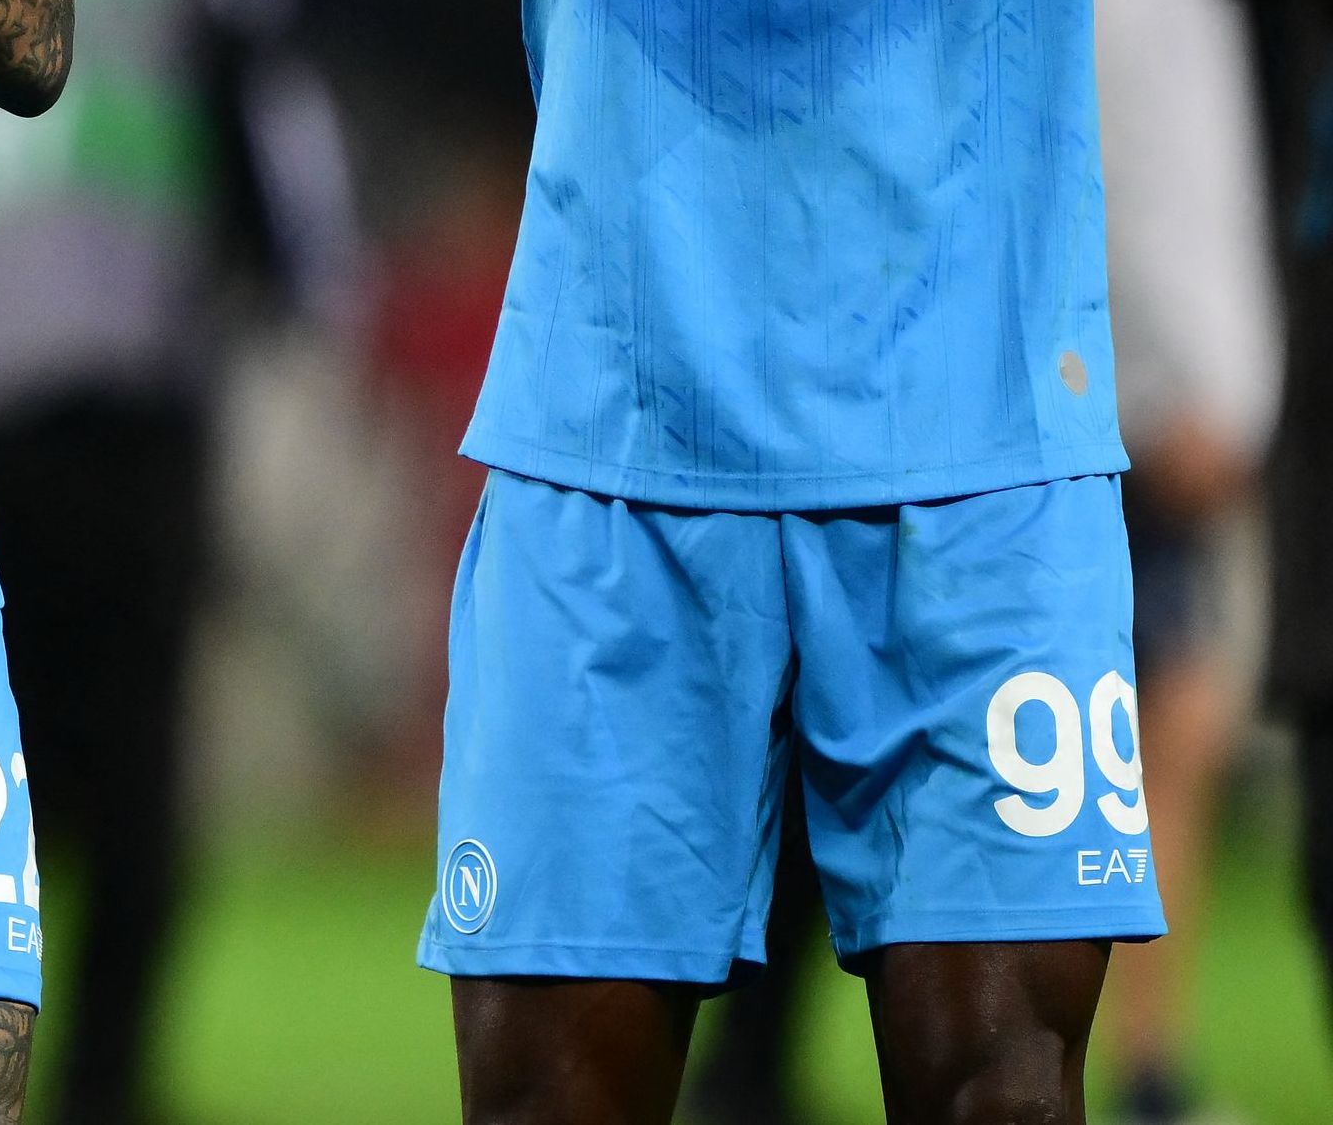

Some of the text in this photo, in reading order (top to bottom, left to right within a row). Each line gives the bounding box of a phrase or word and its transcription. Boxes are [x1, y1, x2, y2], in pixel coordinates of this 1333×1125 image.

[986, 670, 1149, 837] 99
[457, 866, 483, 908] N
[1077, 849, 1148, 886] EA7
